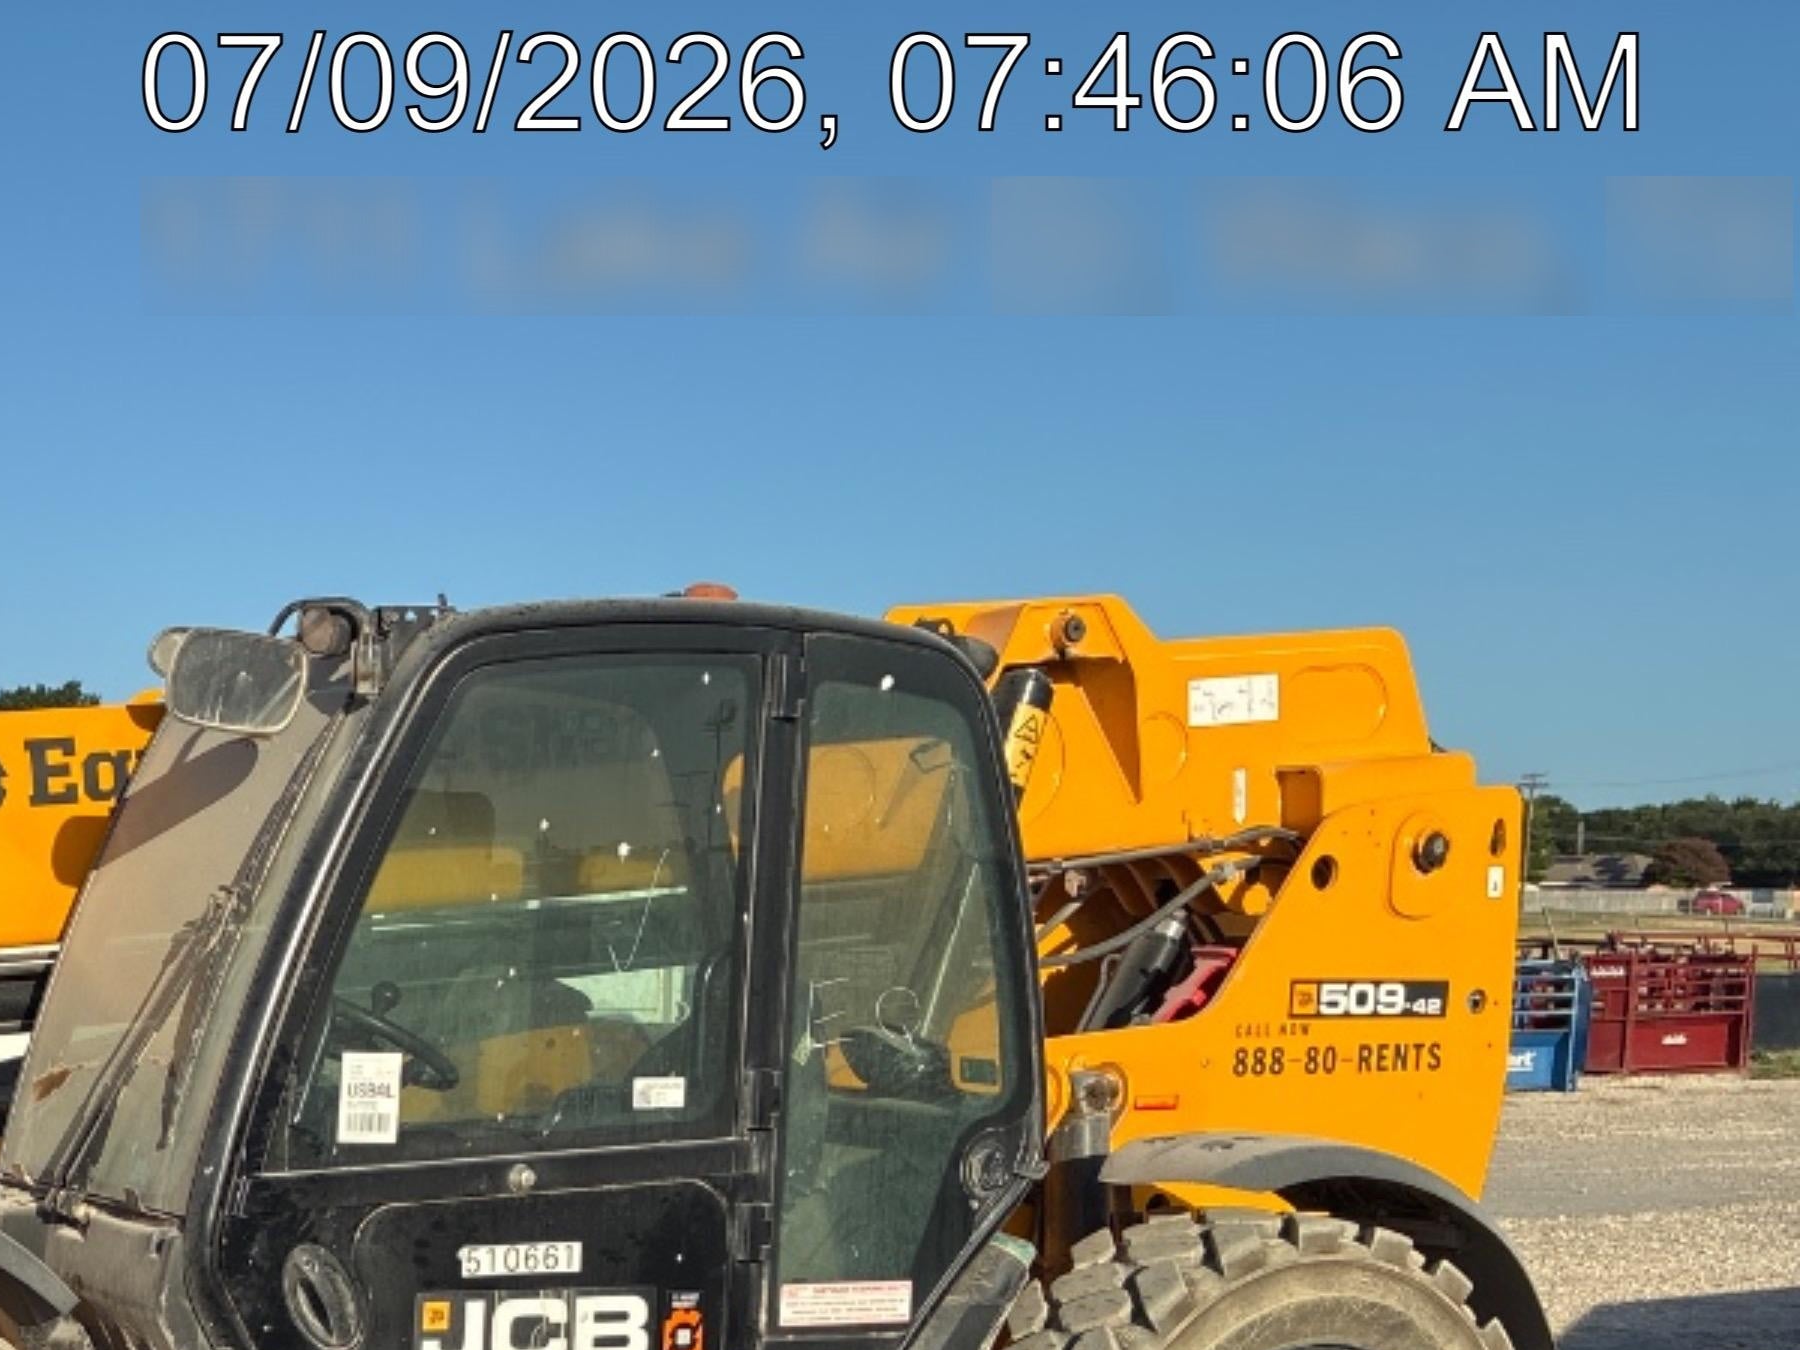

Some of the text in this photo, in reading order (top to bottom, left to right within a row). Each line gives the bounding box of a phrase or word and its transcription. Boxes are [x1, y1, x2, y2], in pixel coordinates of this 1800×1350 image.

[23, 735, 144, 807] Eq
[1231, 1040, 1443, 1079] 888-80-RENTS
[464, 1243, 575, 1275] 510661
